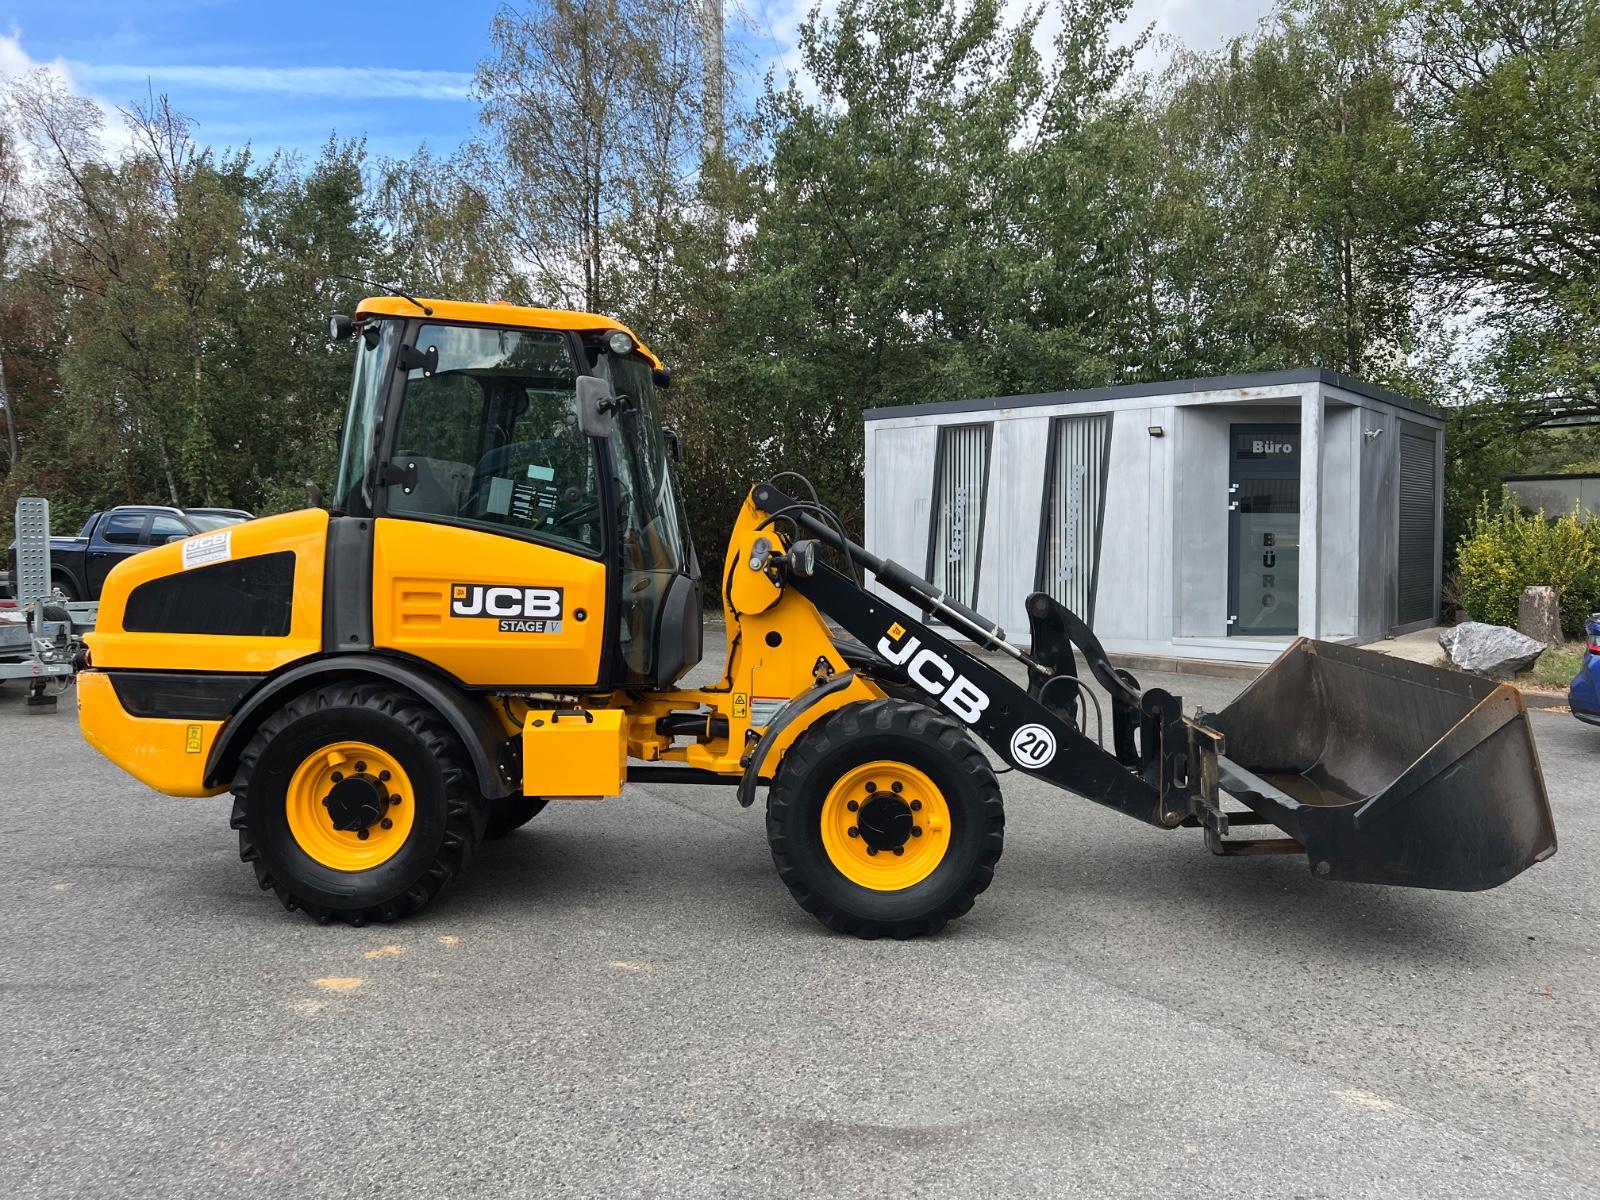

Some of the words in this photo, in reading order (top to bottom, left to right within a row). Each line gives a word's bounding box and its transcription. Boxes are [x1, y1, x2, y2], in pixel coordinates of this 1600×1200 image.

[1252, 440, 1292, 453] Büro
[1262, 533, 1276, 608] BÜRO
[453, 587, 560, 617] JCB
[501, 621, 542, 632] STAGE
[877, 636, 990, 724] JCB
[1017, 732, 1049, 760] 20
